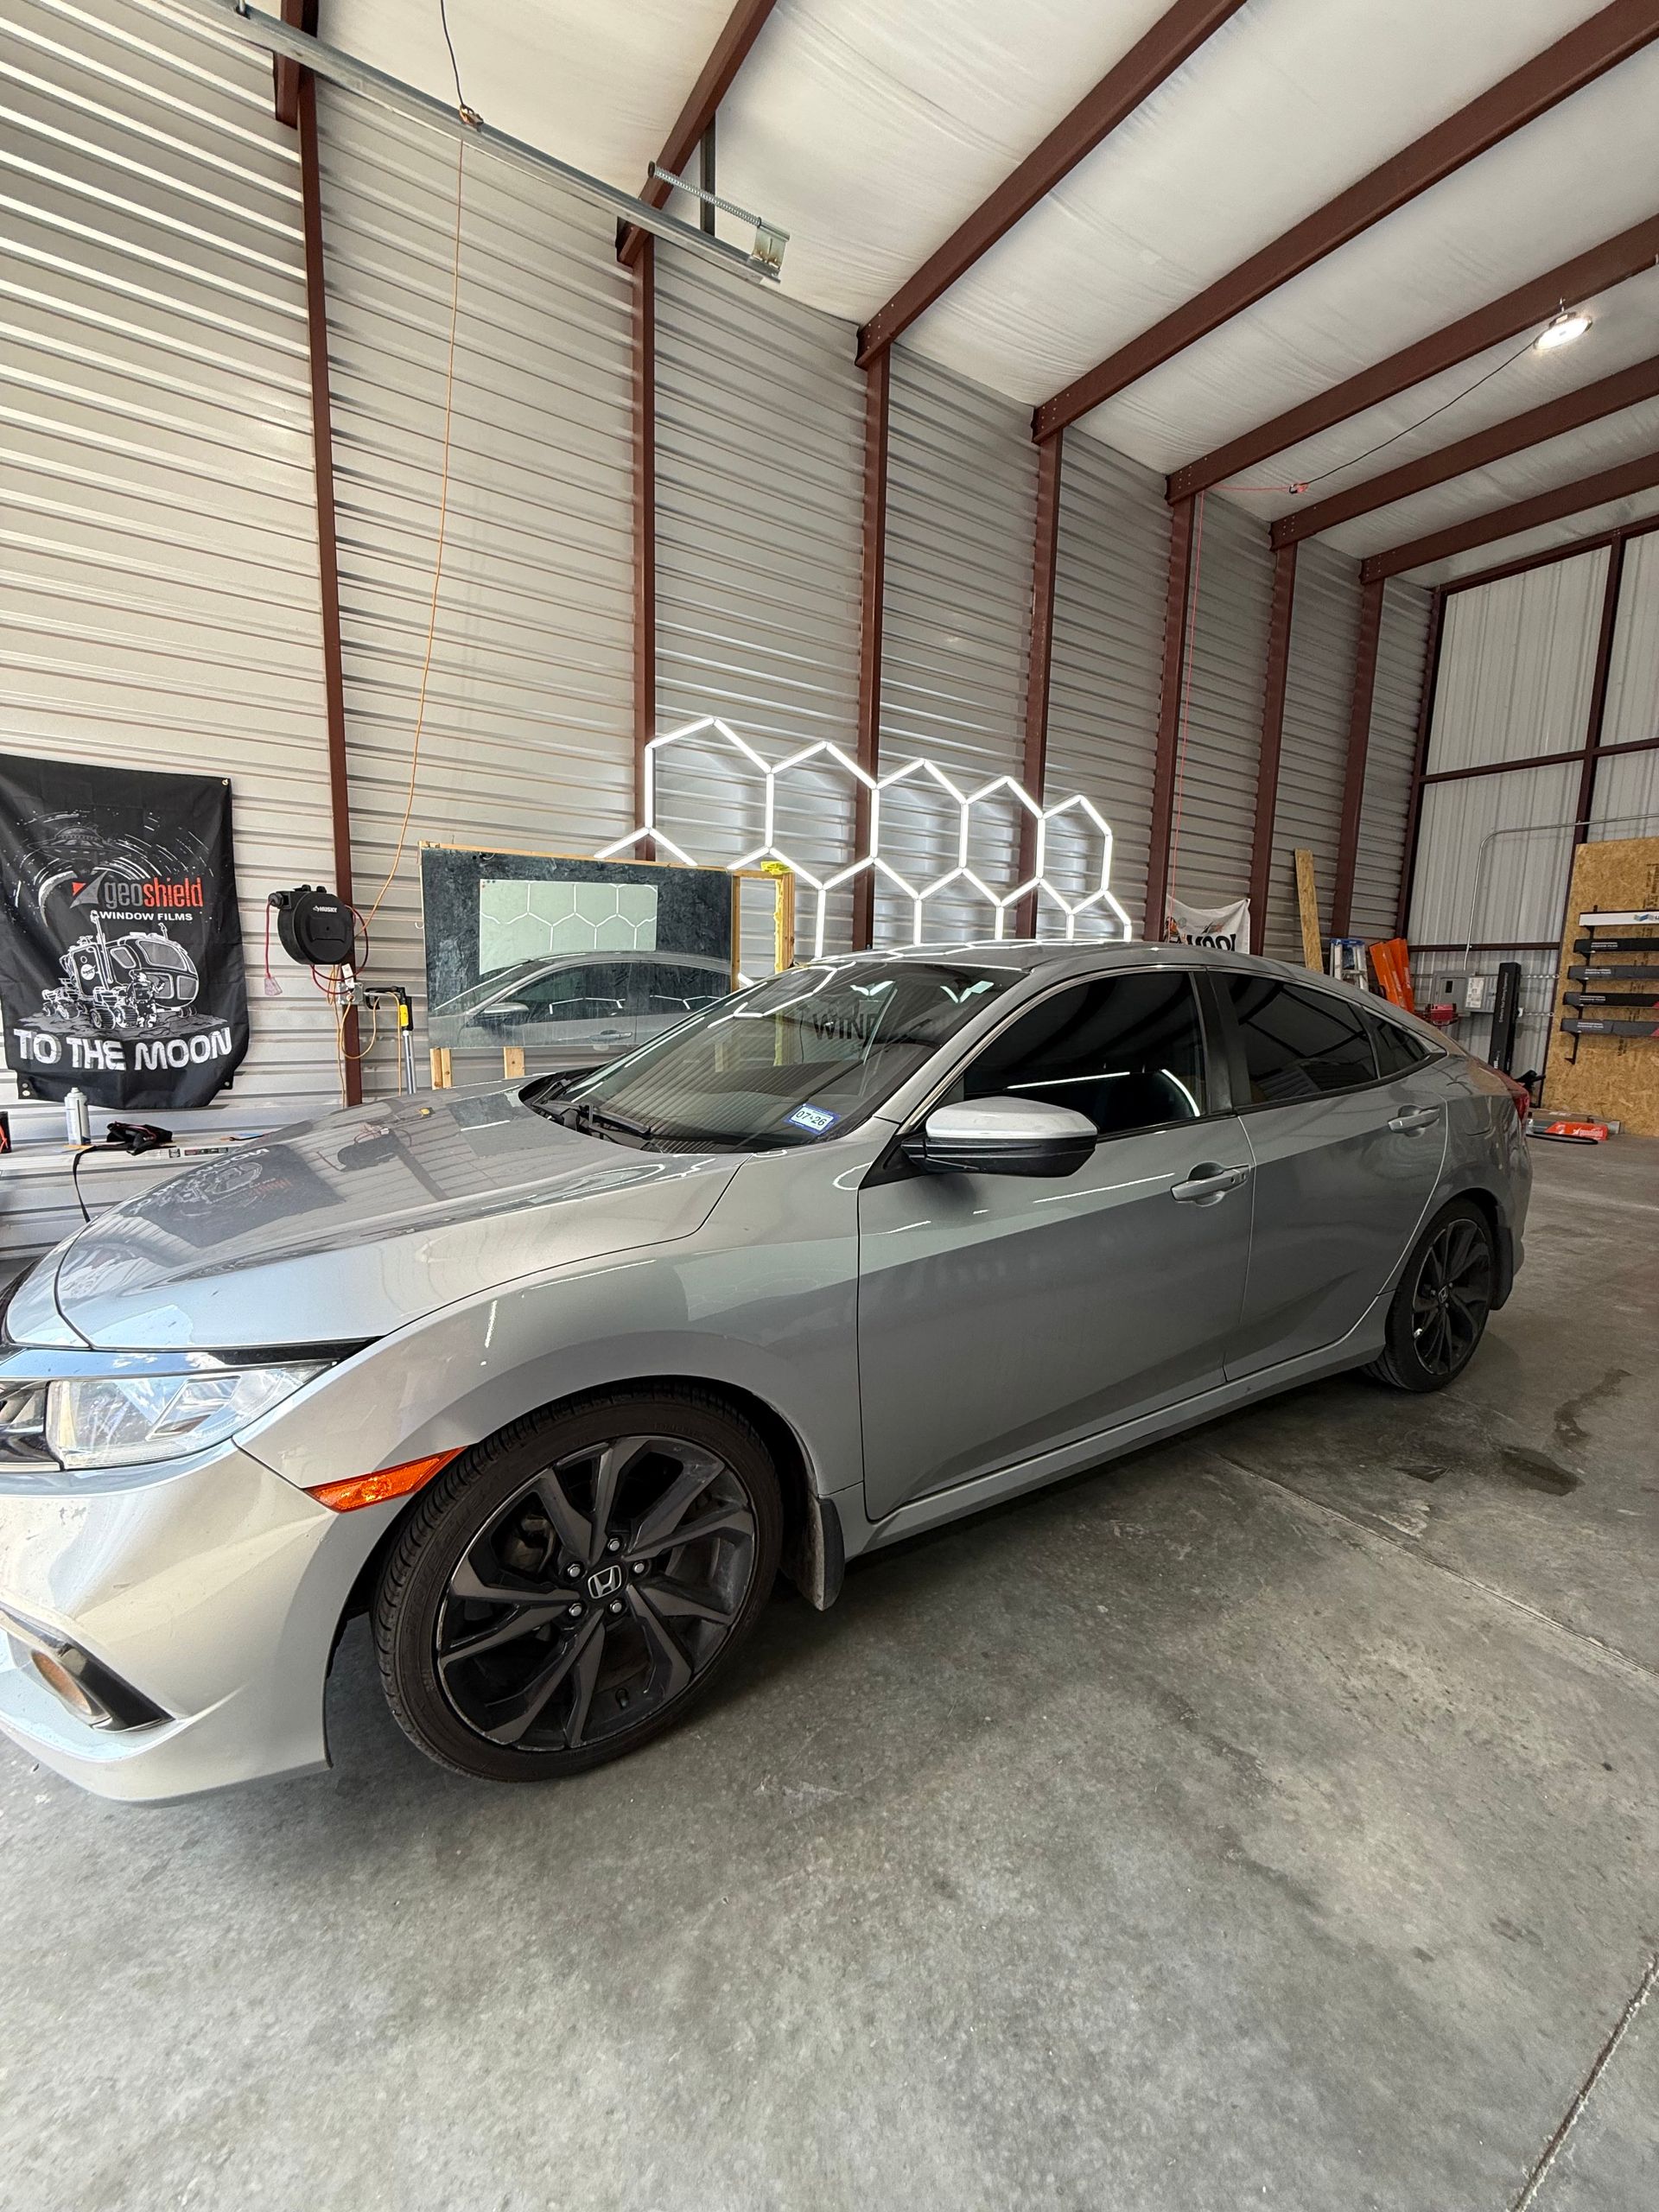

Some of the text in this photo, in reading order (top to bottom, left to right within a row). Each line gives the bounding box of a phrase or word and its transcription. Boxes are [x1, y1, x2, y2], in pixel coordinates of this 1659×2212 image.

[105, 876, 204, 909] geoshield
[99, 911, 194, 921] WINDOW FILMS
[13, 1027, 232, 1071] TO THE MOON
